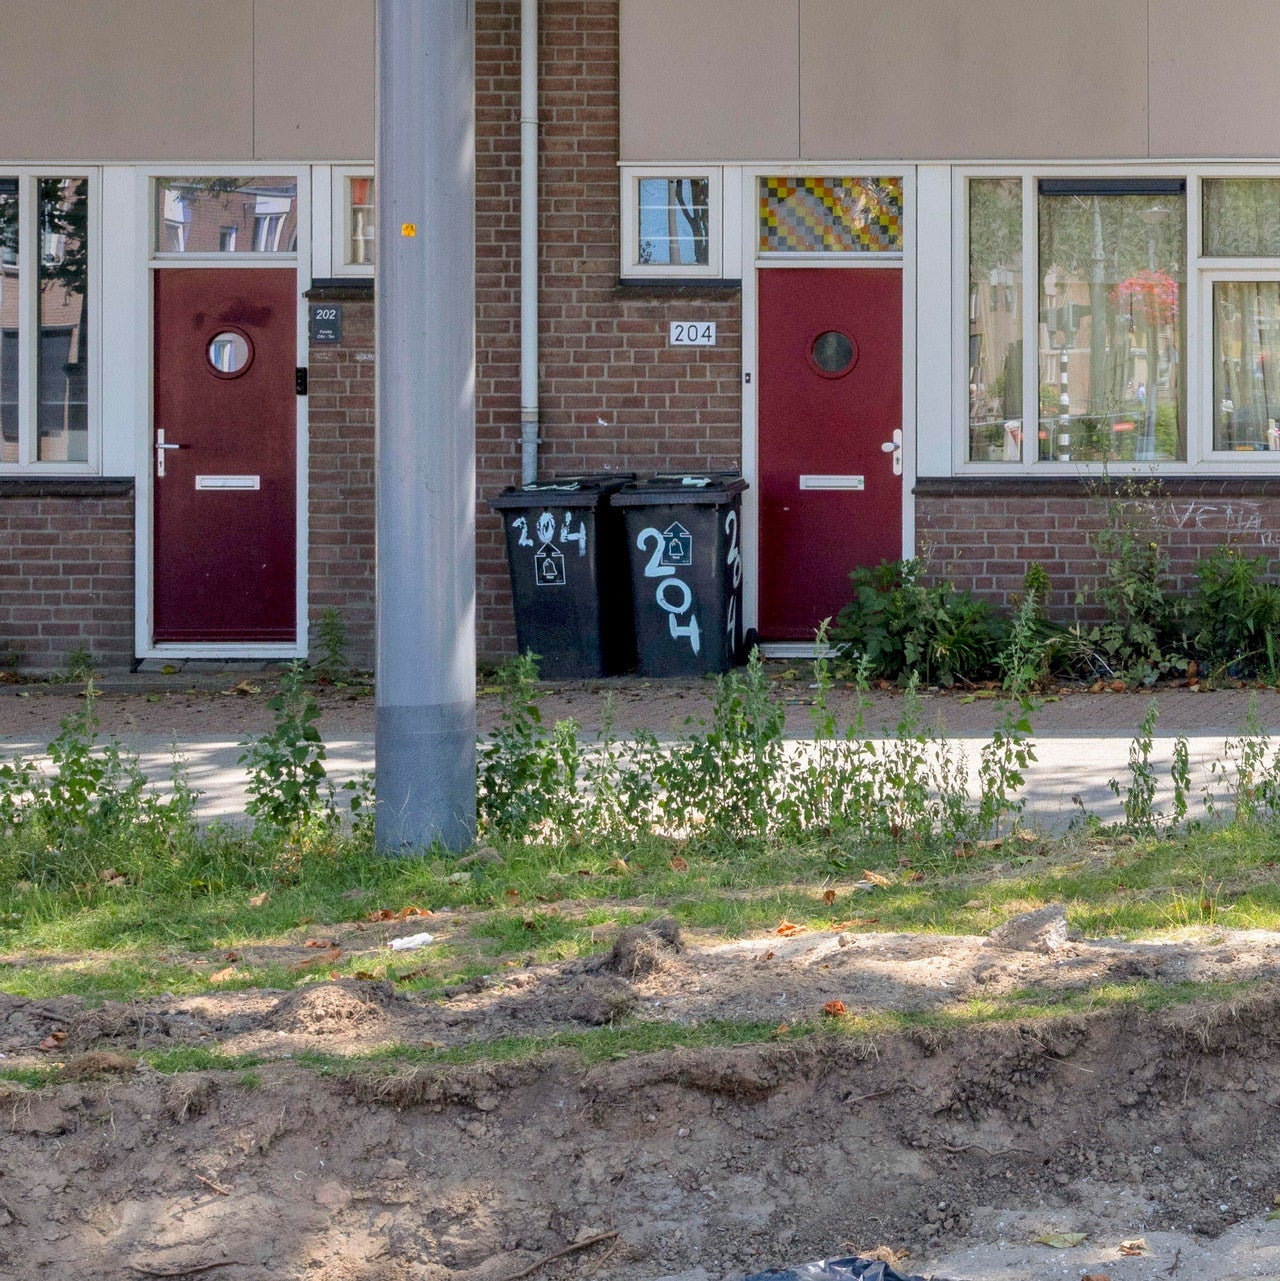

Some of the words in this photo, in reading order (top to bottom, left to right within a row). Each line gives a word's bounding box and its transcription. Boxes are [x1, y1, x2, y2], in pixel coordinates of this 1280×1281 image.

[316, 309, 336, 320] 202
[674, 324, 713, 342] 204
[512, 511, 587, 557] 204
[637, 527, 700, 656] 204
